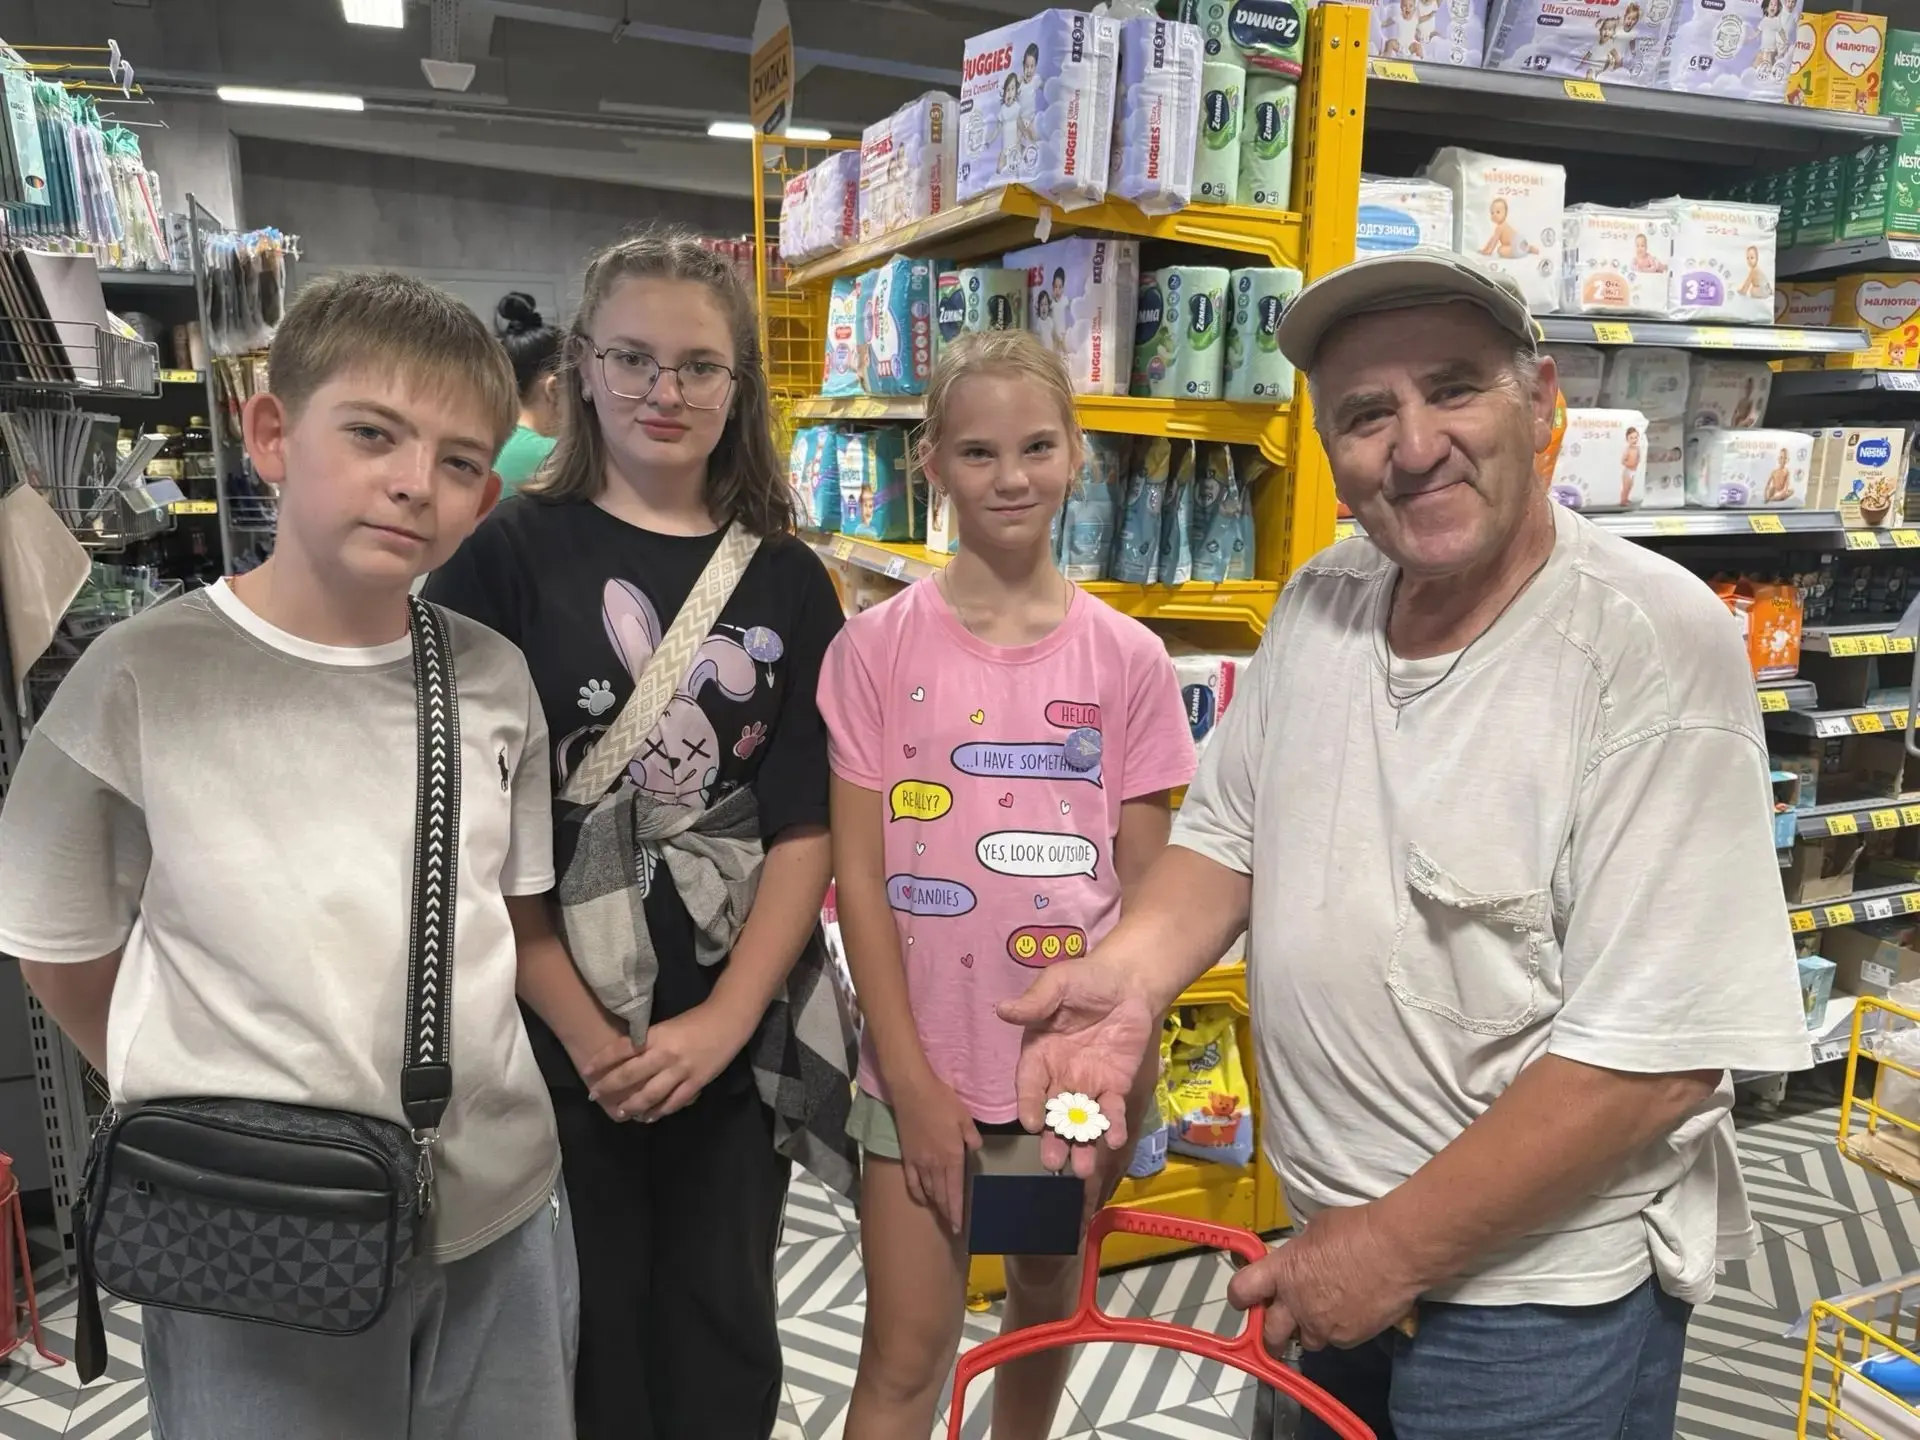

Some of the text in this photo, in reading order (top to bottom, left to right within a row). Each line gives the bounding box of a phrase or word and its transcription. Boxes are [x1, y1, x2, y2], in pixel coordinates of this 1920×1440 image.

[1542, 4, 1600, 18] Ultra Comfort
[962, 46, 1013, 82] HUGGIES
[1523, 55, 1532, 66] 4
[1536, 57, 1548, 66] 38
[1689, 55, 1697, 68] 6
[1700, 57, 1711, 67] 32
[753, 54, 789, 102] СКИДКА
[1802, 70, 1814, 96] 1
[1866, 72, 1880, 98] 2
[1064, 121, 1078, 176] HUGGIES
[1147, 127, 1161, 179] HUGGIES
[1685, 279, 1698, 300] 3
[1864, 295, 1917, 308] малютка
[1904, 324, 1919, 348] 2
[1091, 335, 1102, 382] HUGGIES
[1061, 705, 1096, 725] HELLO
[984, 752, 1014, 770] HAVE
[1019, 753, 1089, 773] SOMETH
[902, 789, 939, 812] REALLY?
[983, 844, 1091, 864] YES, LOOK OUTSIDE
[911, 887, 960, 907] CANDIES
